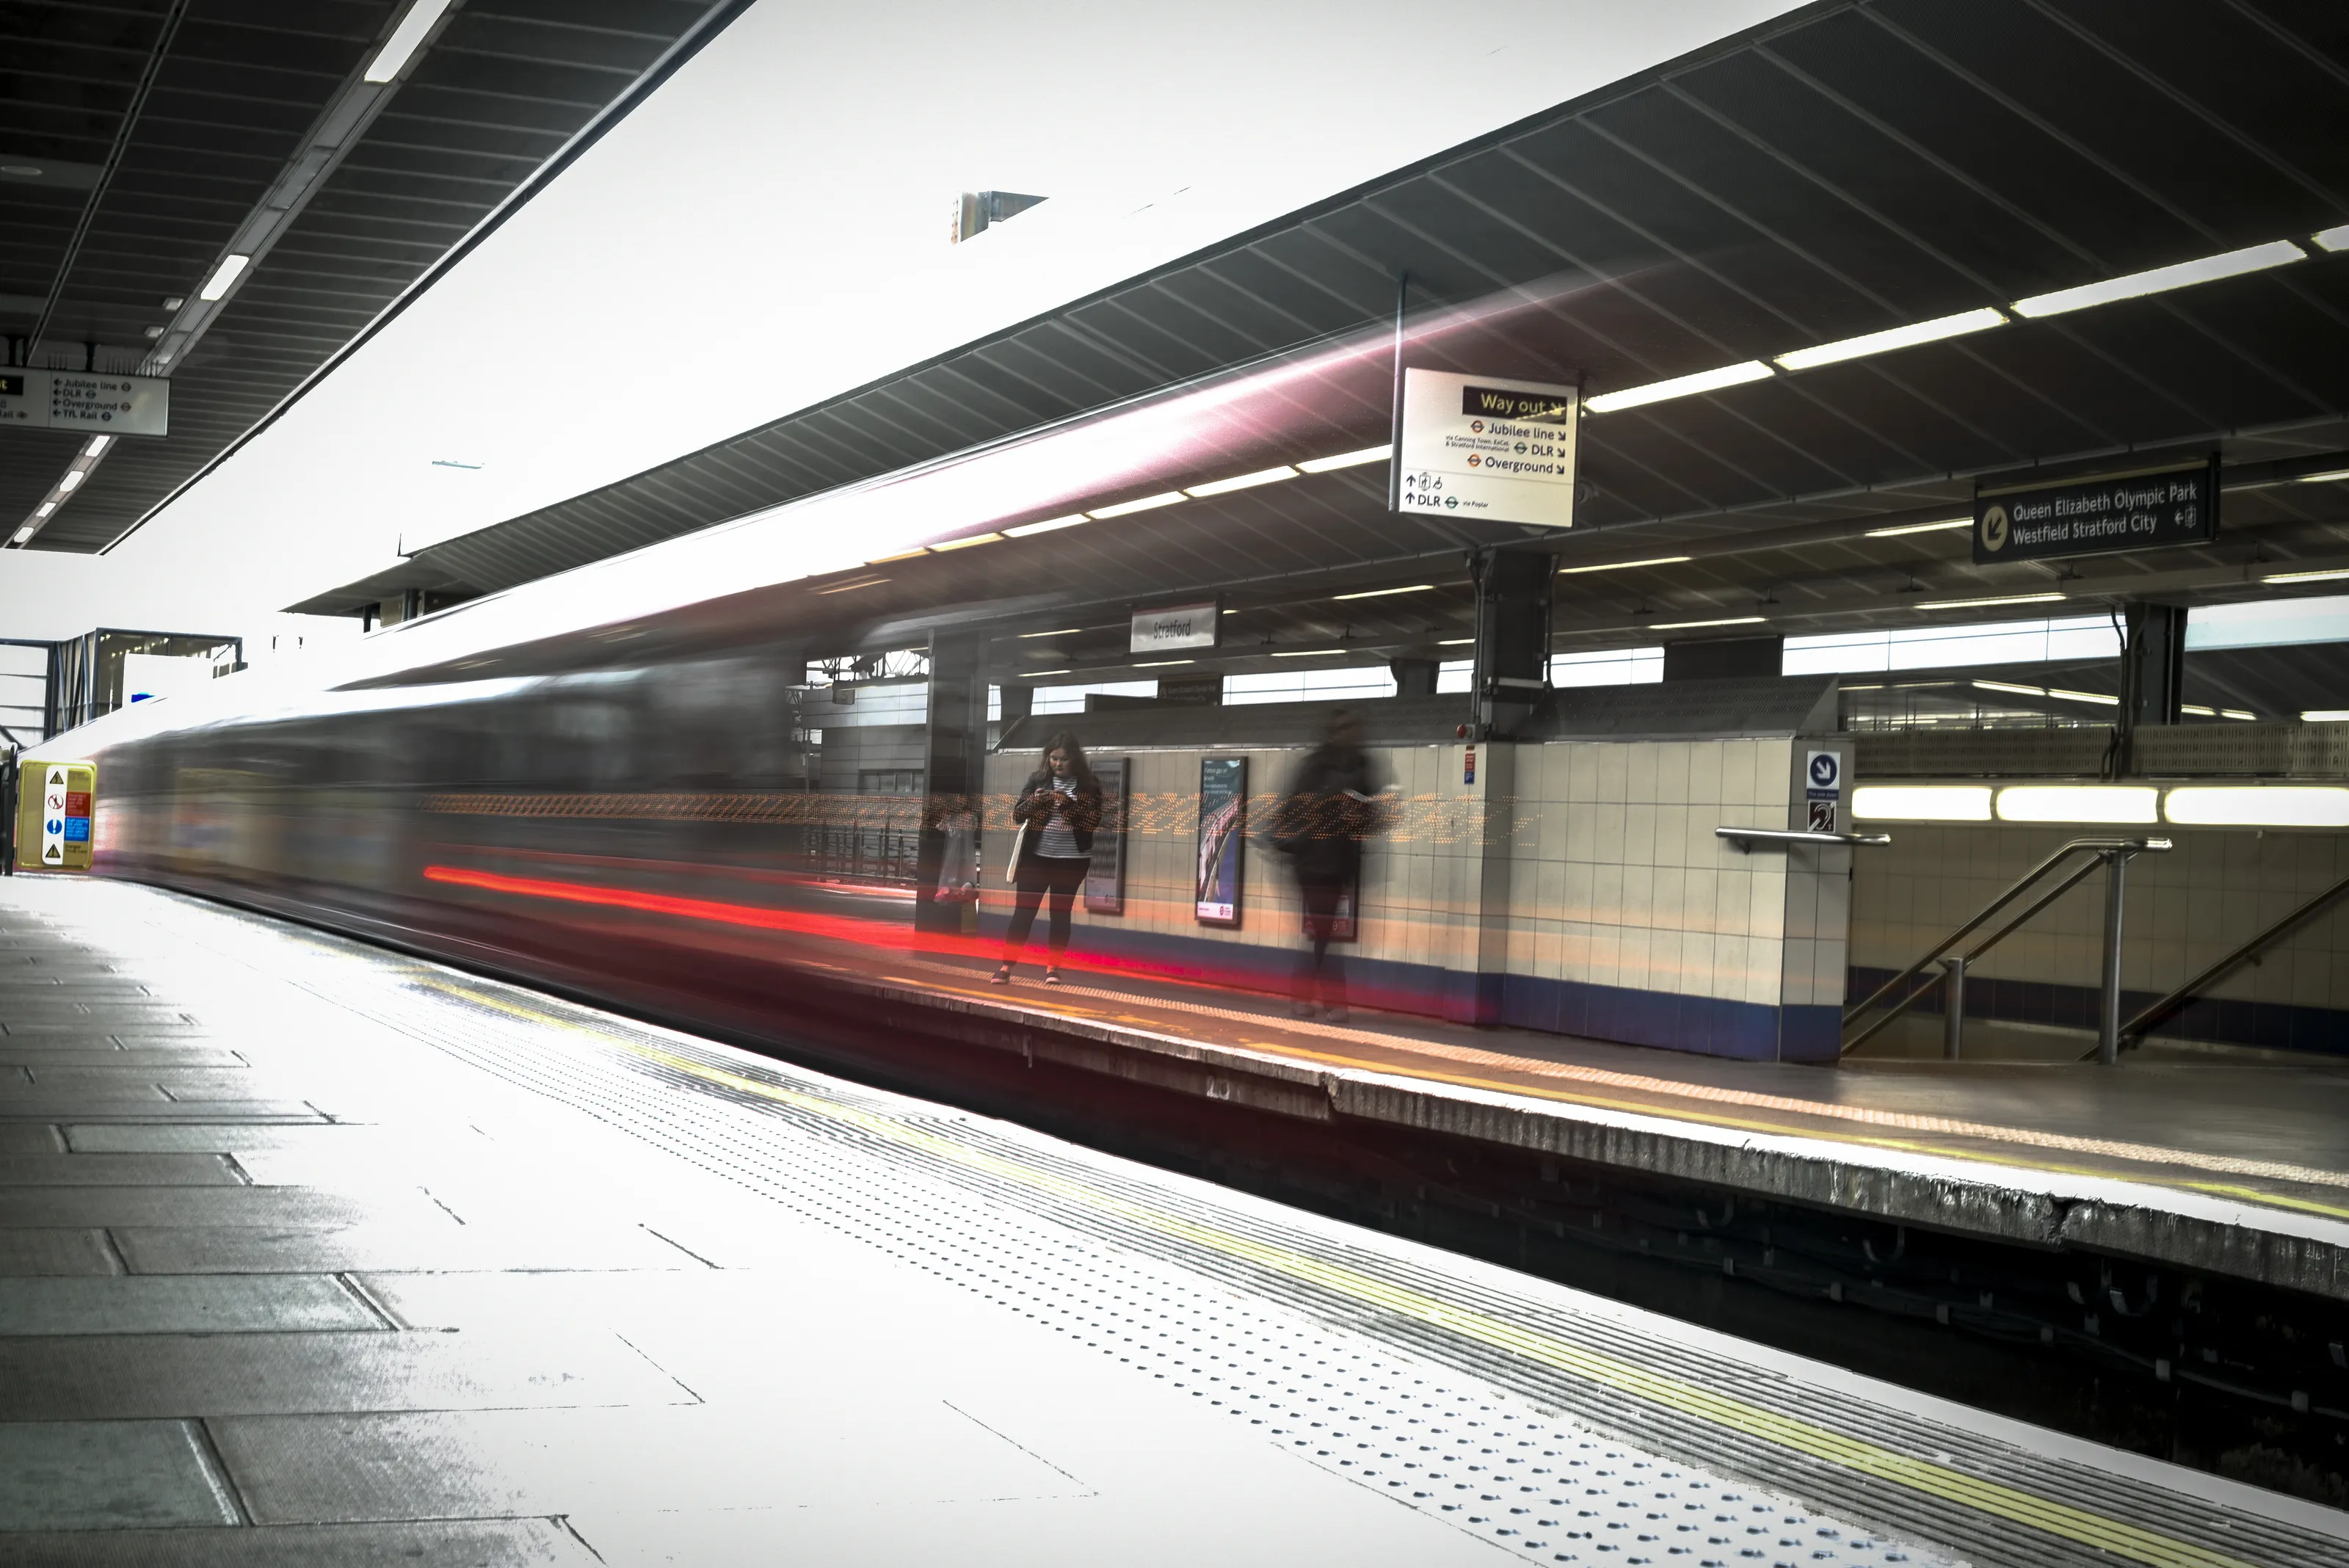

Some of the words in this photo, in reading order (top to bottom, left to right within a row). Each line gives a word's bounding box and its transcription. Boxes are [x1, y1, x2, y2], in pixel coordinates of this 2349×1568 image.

[65, 379, 97, 389] Jubilee
[101, 381, 117, 391] line
[63, 389, 81, 397] DLR
[63, 399, 117, 410] Overground
[1481, 392, 1514, 415] Way
[1519, 400, 1546, 413] out
[64, 410, 77, 418] TfL
[80, 410, 97, 420] Rail
[1489, 423, 1530, 438] Jubilee
[1533, 427, 1554, 440] line
[1531, 444, 1553, 457] DLR
[1485, 456, 1553, 473] Overground
[1417, 495, 1440, 507] DLR
[2014, 502, 2052, 521] Queen
[2055, 491, 2110, 517] Elizabeth
[2114, 487, 2165, 512] Olympic
[2169, 481, 2197, 501] Park
[2014, 521, 2069, 545] Westfield
[2073, 515, 2126, 537] Stratford
[2131, 512, 2157, 534] City
[1153, 618, 1191, 640] Stratford
